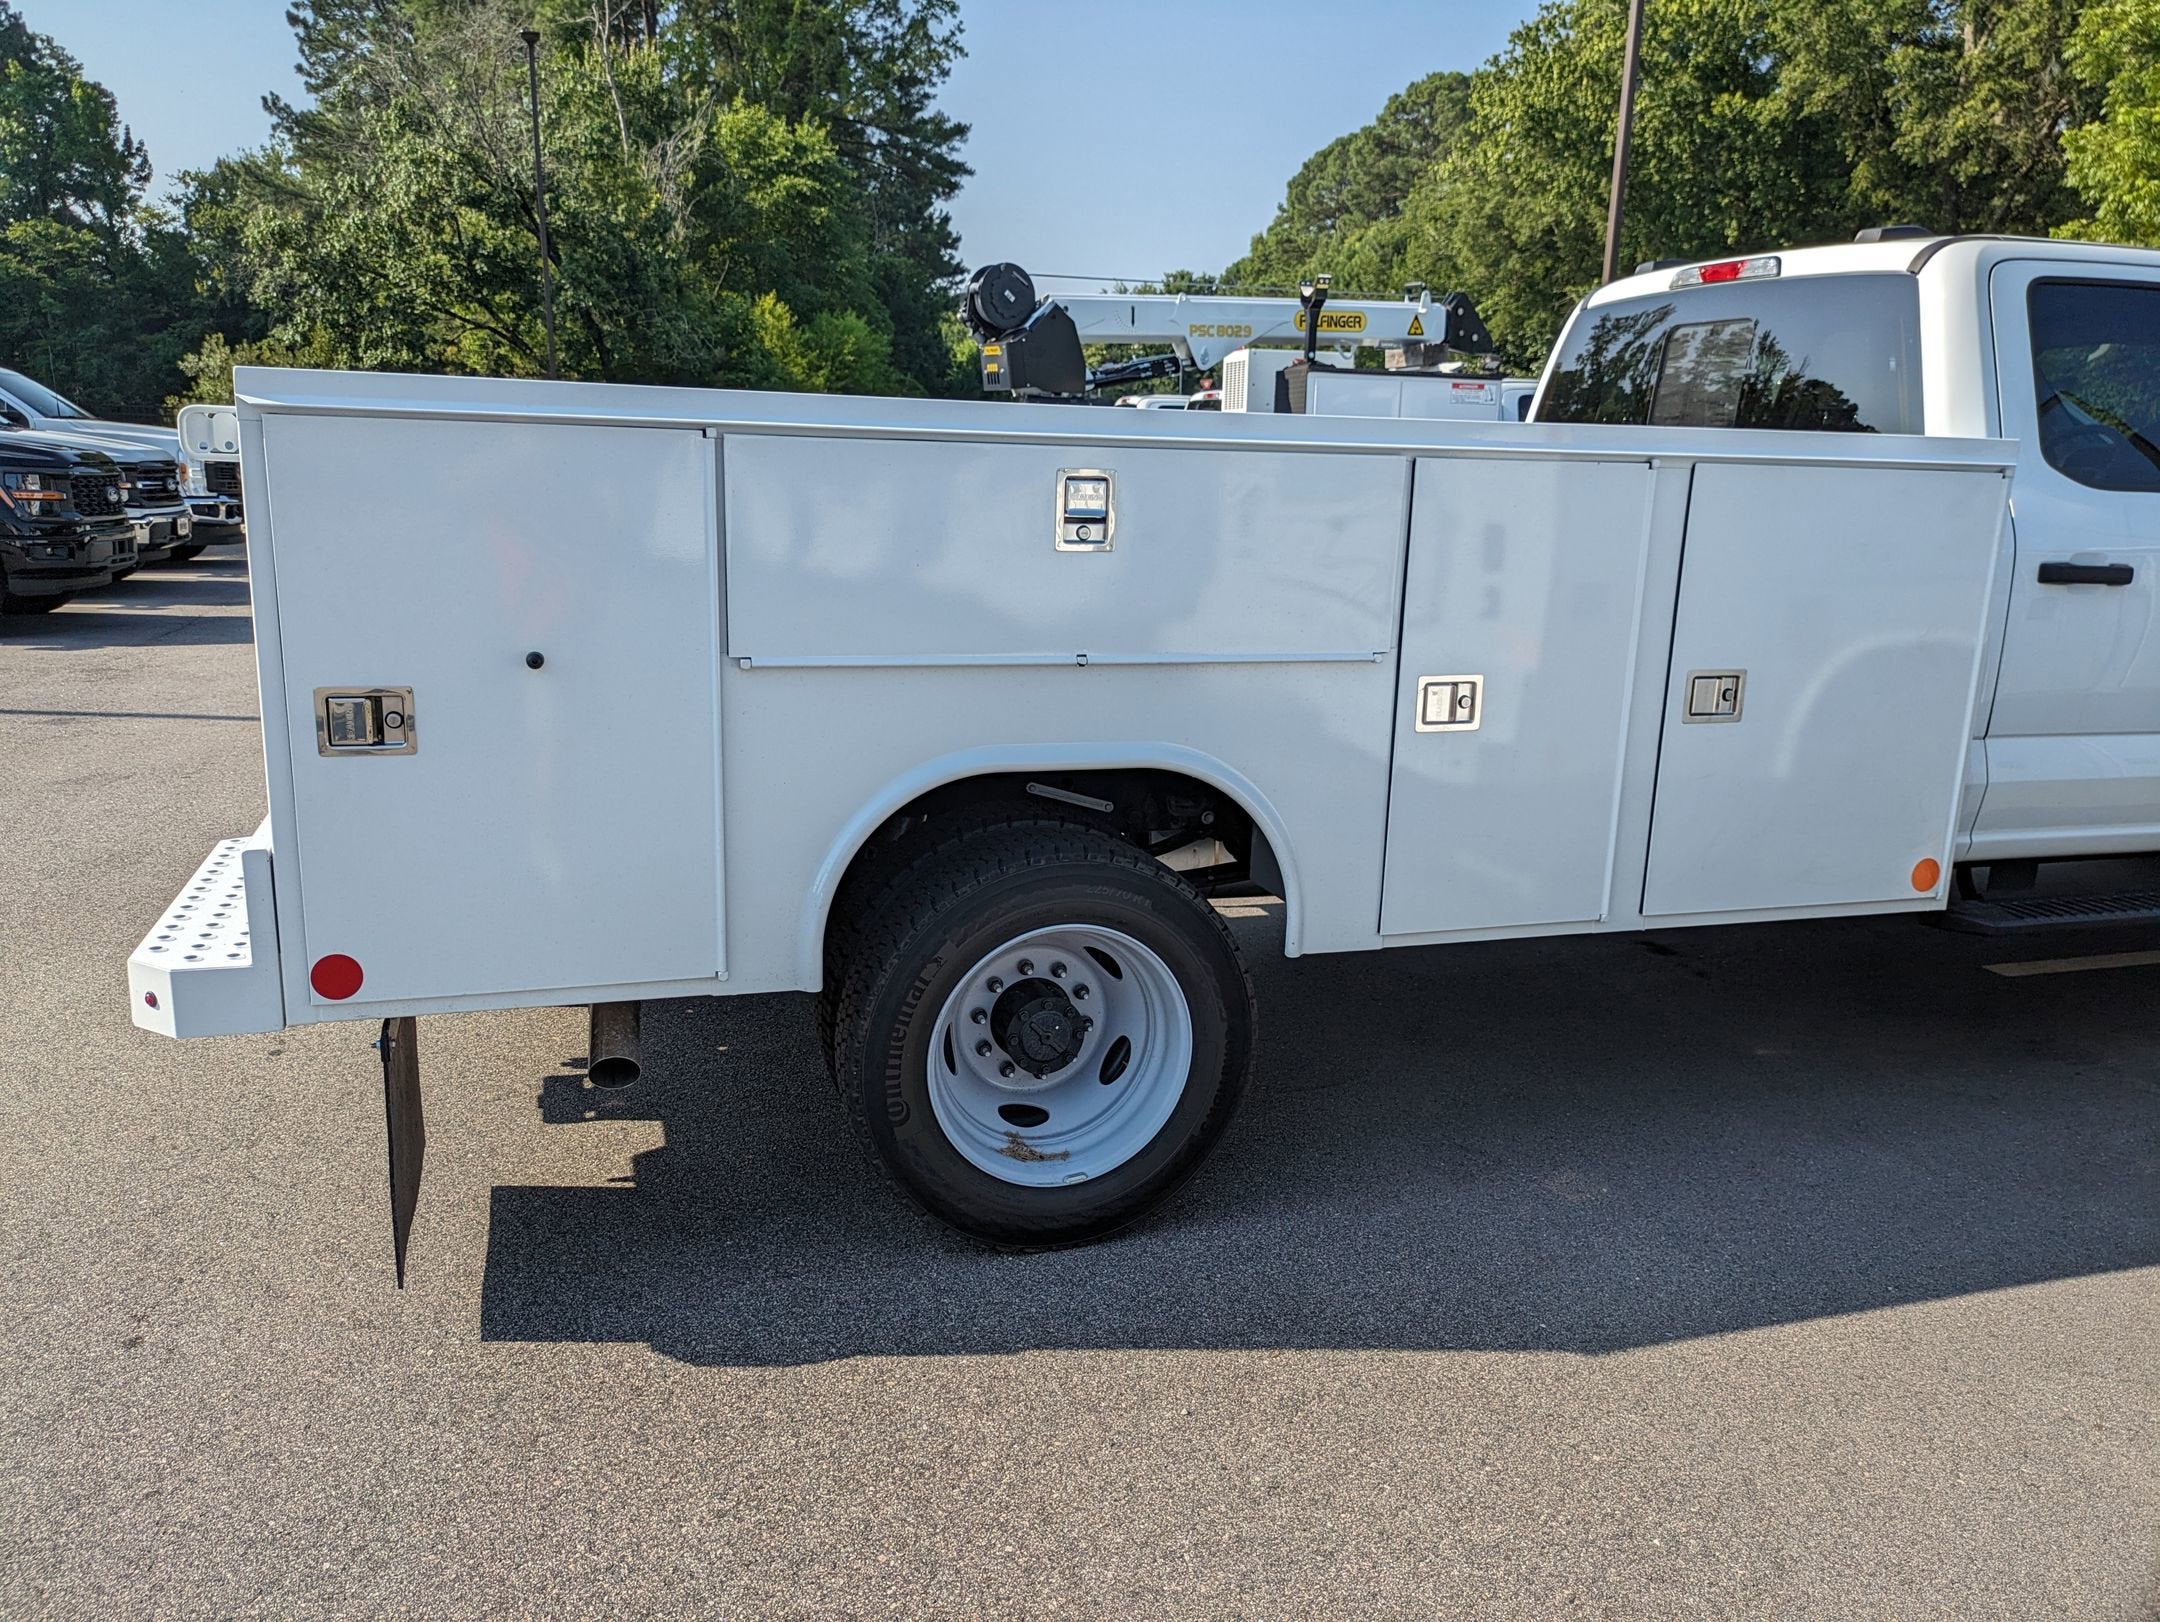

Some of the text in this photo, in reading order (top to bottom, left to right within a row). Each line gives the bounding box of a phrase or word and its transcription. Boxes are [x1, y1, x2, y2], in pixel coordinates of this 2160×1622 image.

[1299, 314, 1362, 329] PFINGER
[1189, 324, 1252, 338] PSC 8029
